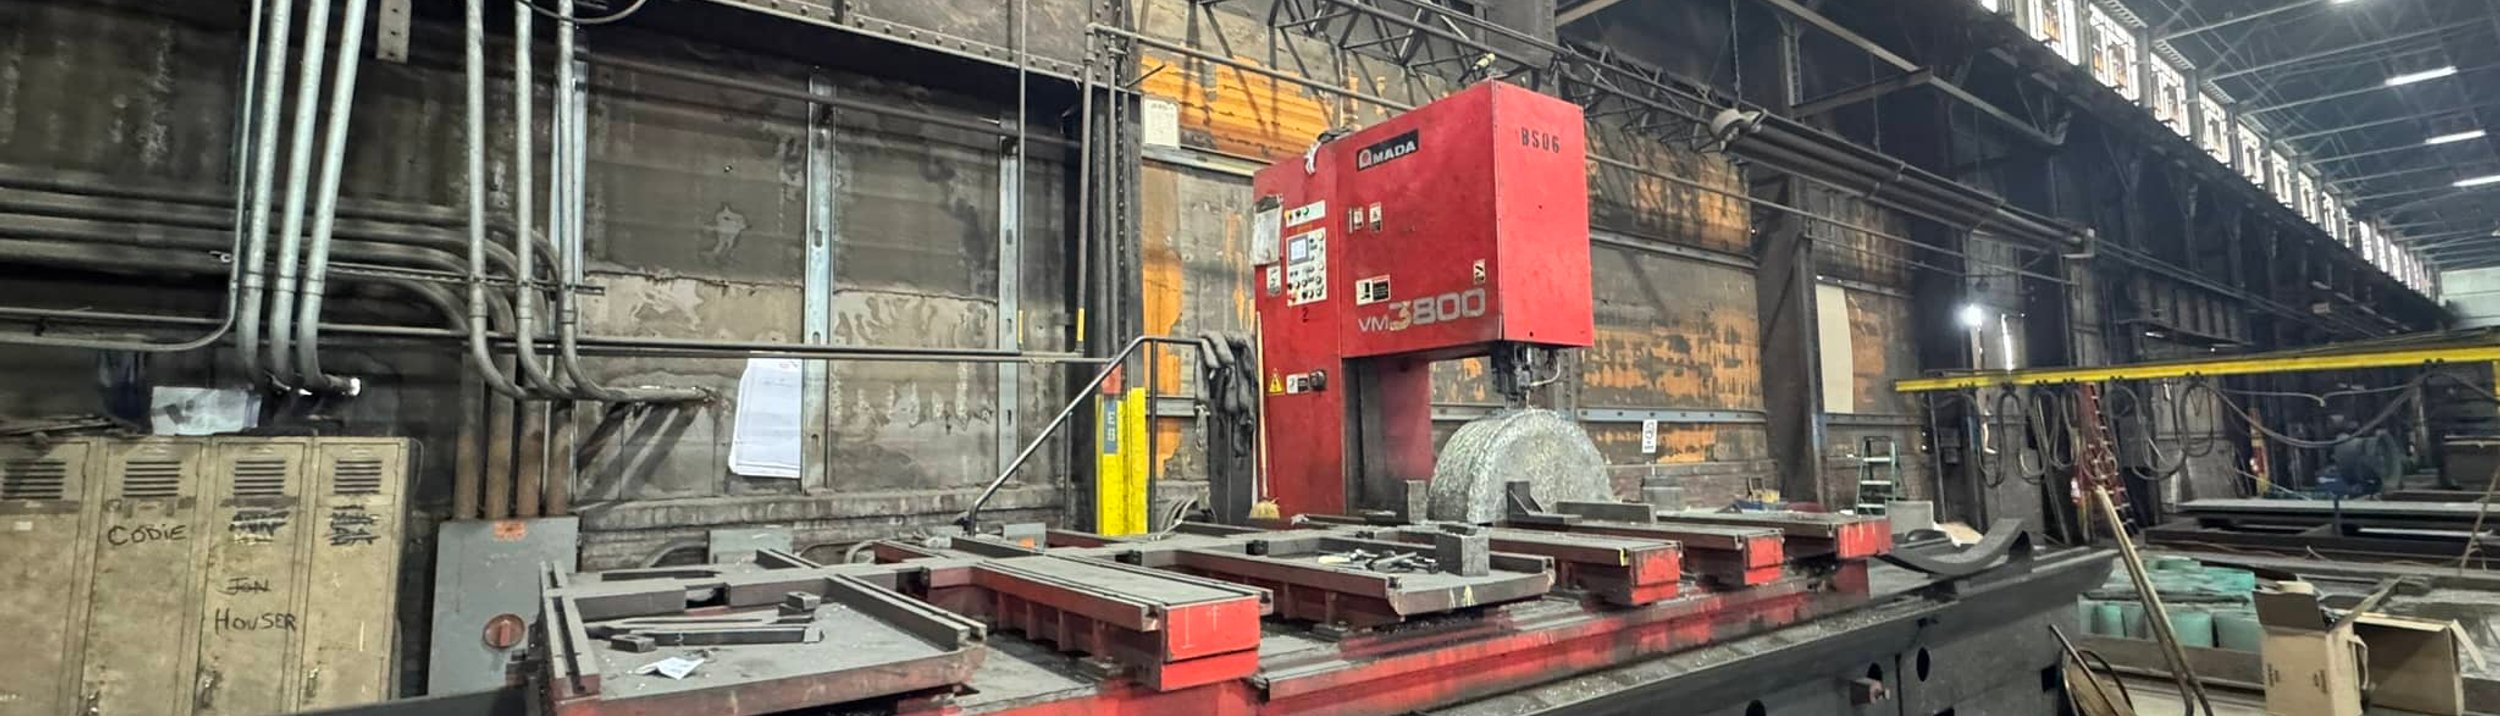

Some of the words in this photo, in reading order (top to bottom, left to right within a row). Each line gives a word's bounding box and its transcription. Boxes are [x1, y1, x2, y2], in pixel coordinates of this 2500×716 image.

[1521, 126, 1560, 154] BS06
[1358, 287, 1486, 332] VM3800
[214, 607, 297, 635] HOUSER
